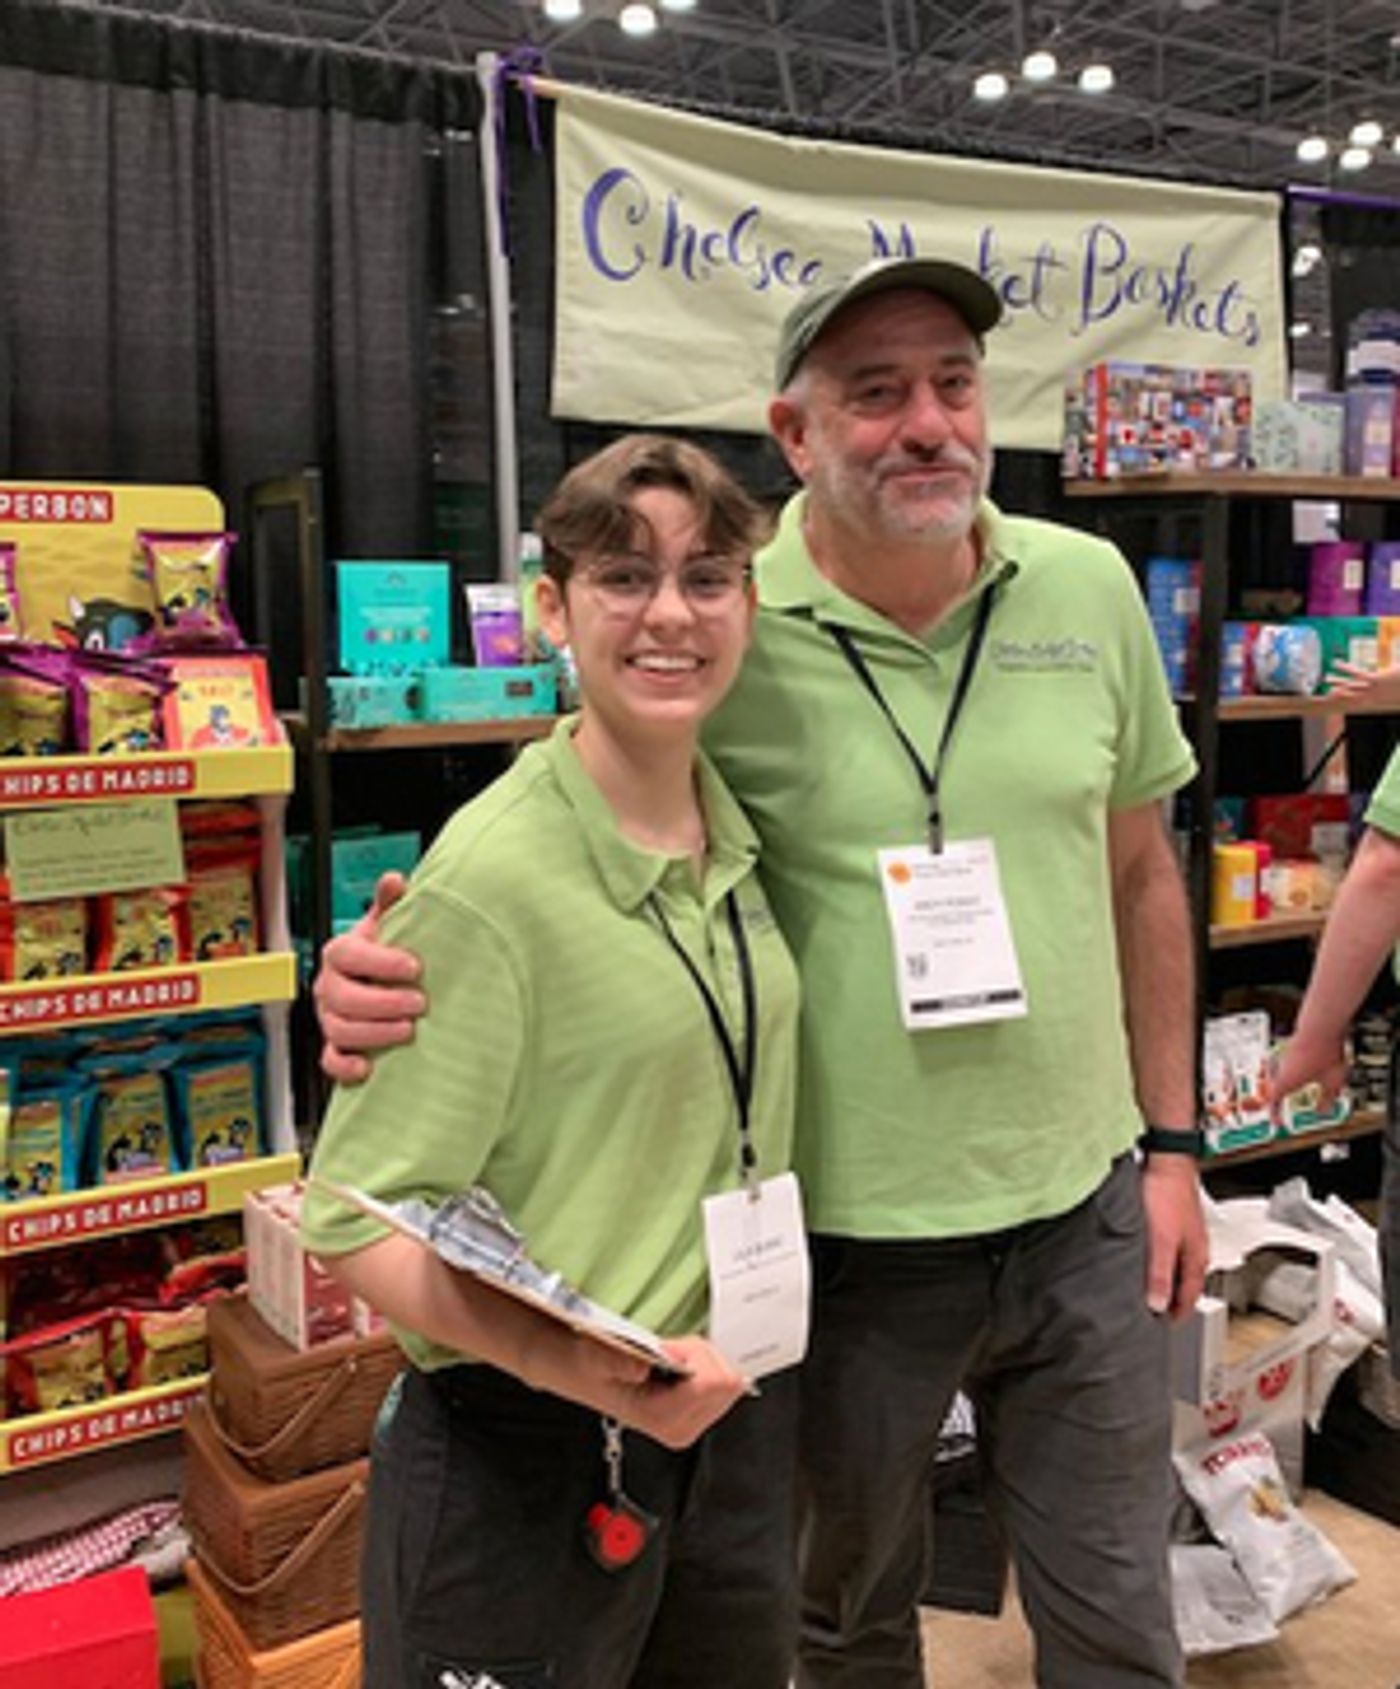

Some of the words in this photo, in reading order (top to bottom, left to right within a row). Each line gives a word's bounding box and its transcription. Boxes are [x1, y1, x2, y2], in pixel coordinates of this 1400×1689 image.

[583, 167, 822, 290] Chelsea
[867, 218, 1068, 327] Mket
[1071, 223, 1260, 347] Baskets
[67, 771, 97, 795] DE
[102, 764, 188, 791] MADRID
[74, 990, 102, 1014] DE
[108, 979, 194, 1009] MADRID
[8, 1213, 76, 1243] CHIPS
[83, 1205, 112, 1229] DE
[117, 1189, 201, 1221] MADRID
[14, 1423, 84, 1458] CHIPS
[89, 1415, 117, 1440] DE
